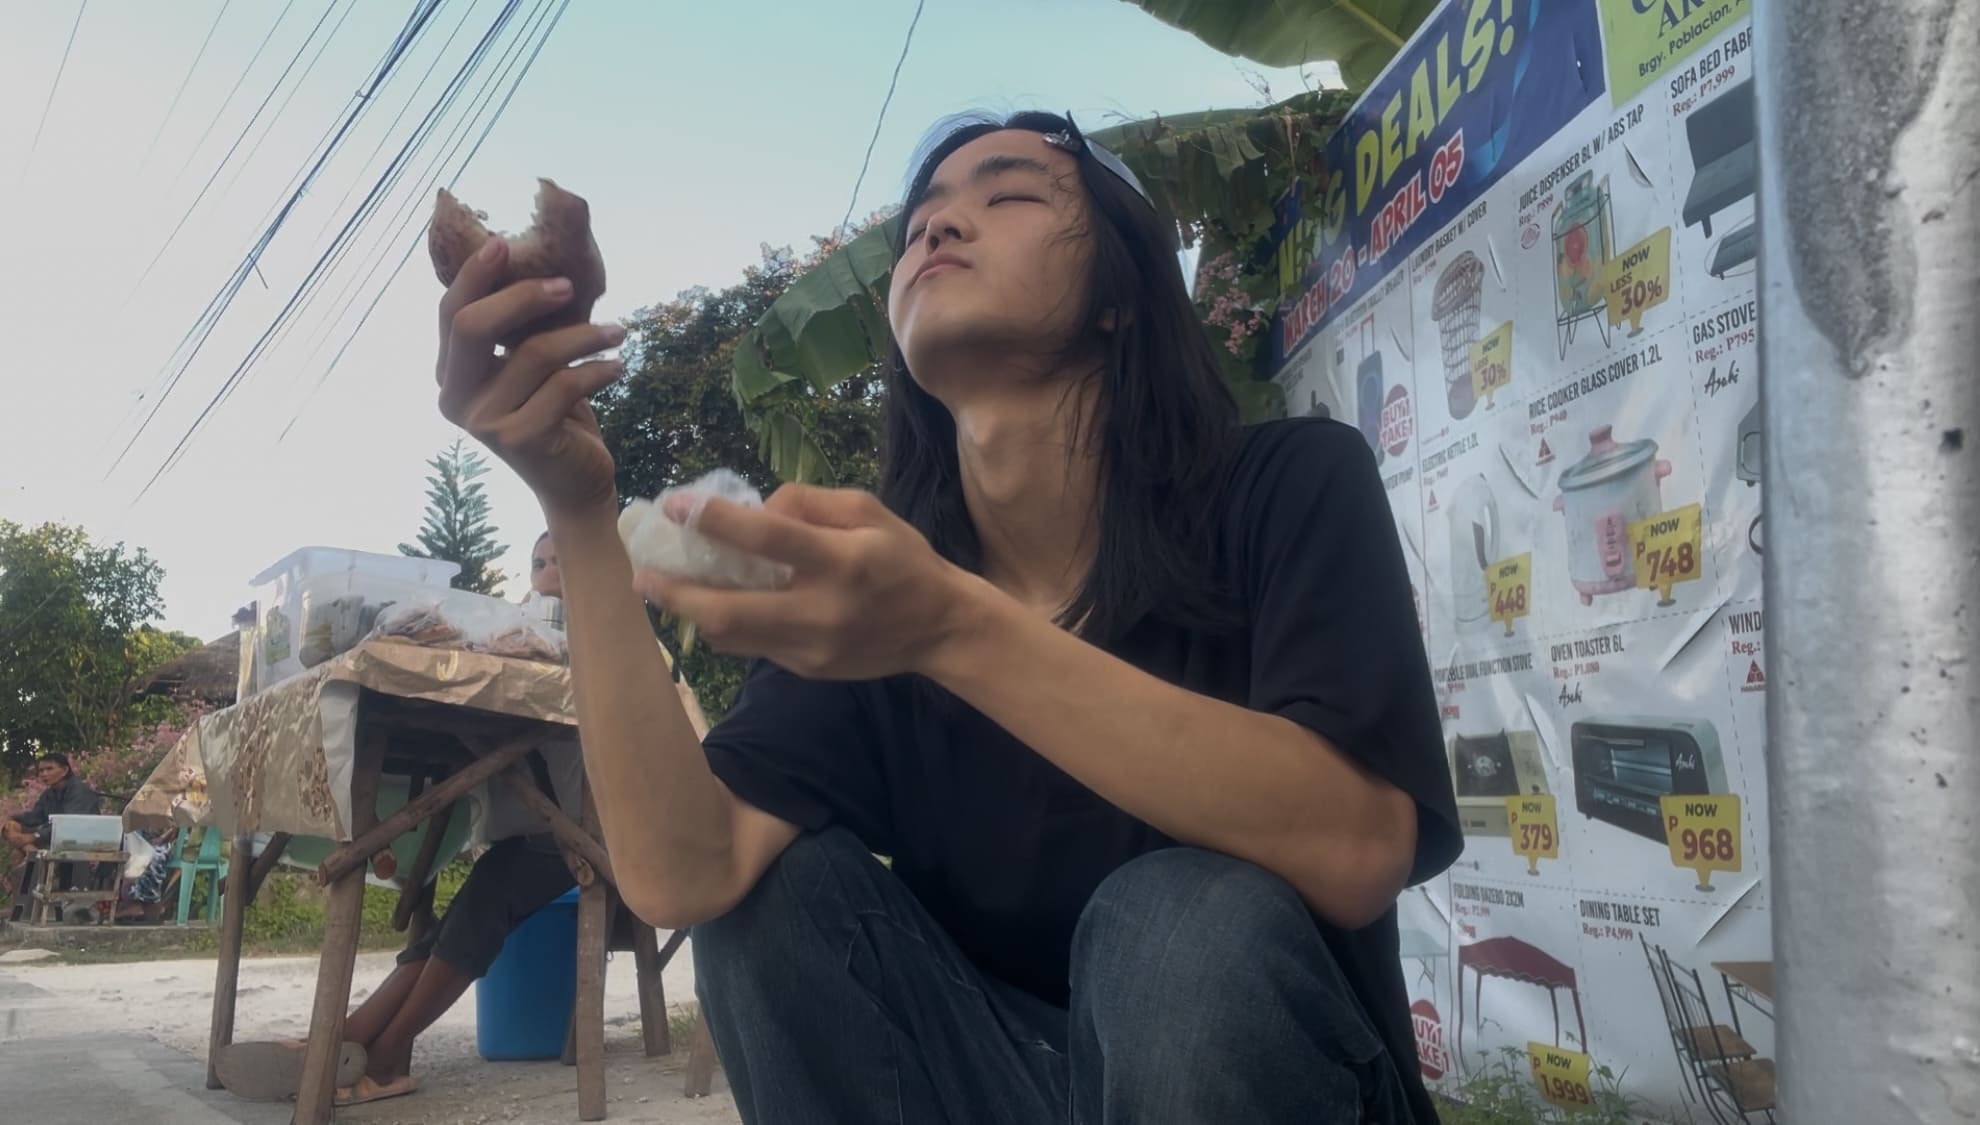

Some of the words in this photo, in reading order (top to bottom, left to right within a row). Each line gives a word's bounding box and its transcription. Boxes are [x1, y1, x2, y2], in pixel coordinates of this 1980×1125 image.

[1638, 52, 1667, 77] Brgy.
[1670, 66, 1697, 99] SOFA
[1699, 48, 1721, 79] BED
[1518, 184, 1538, 213] JUICE
[1539, 152, 1580, 197] DISPENSER
[1608, 117, 1625, 145] ABS
[1626, 103, 1645, 130] TAP
[1435, 225, 1456, 253] BASKET
[1467, 200, 1487, 228] COVER
[1282, 272, 1328, 358] MARCH
[1329, 245, 1356, 308] 20
[1370, 169, 1427, 265] APRIL
[1428, 127, 1465, 204] 05
[1622, 246, 1650, 272] NOW
[1610, 272, 1633, 294] LESS
[1621, 276, 1662, 315] 30%
[1693, 319, 1716, 345] GAS
[1718, 301, 1757, 338] STOVE
[1482, 336, 1500, 354] NOW
[1695, 344, 1724, 364] Reg.:
[1726, 329, 1755, 352] P795
[1480, 360, 1508, 392] 30%
[1528, 397, 1547, 419] RICE
[1548, 381, 1580, 410] COOKER
[1580, 368, 1607, 395] GLASS
[1609, 353, 1639, 383] COVER
[1640, 343, 1663, 367] 1.2L
[1650, 518, 1680, 537] NOW
[1499, 564, 1518, 579] NOW
[1646, 542, 1695, 582] 748
[1494, 584, 1526, 615] 448
[1729, 611, 1764, 635] WIND
[1551, 641, 1573, 662] OVEN
[1574, 636, 1612, 657] TOASTER
[1731, 640, 1761, 655] Reg.:
[1522, 802, 1542, 814] NOW
[1685, 803, 1718, 818] NOW
[1520, 824, 1552, 850] 379
[1681, 828, 1734, 861] 968
[1580, 899, 1611, 921] DINING
[1611, 903, 1641, 925] TABLE
[1642, 906, 1660, 927] SET
[1546, 1053, 1572, 1070] NOW
[1540, 1074, 1590, 1105] 1,999
